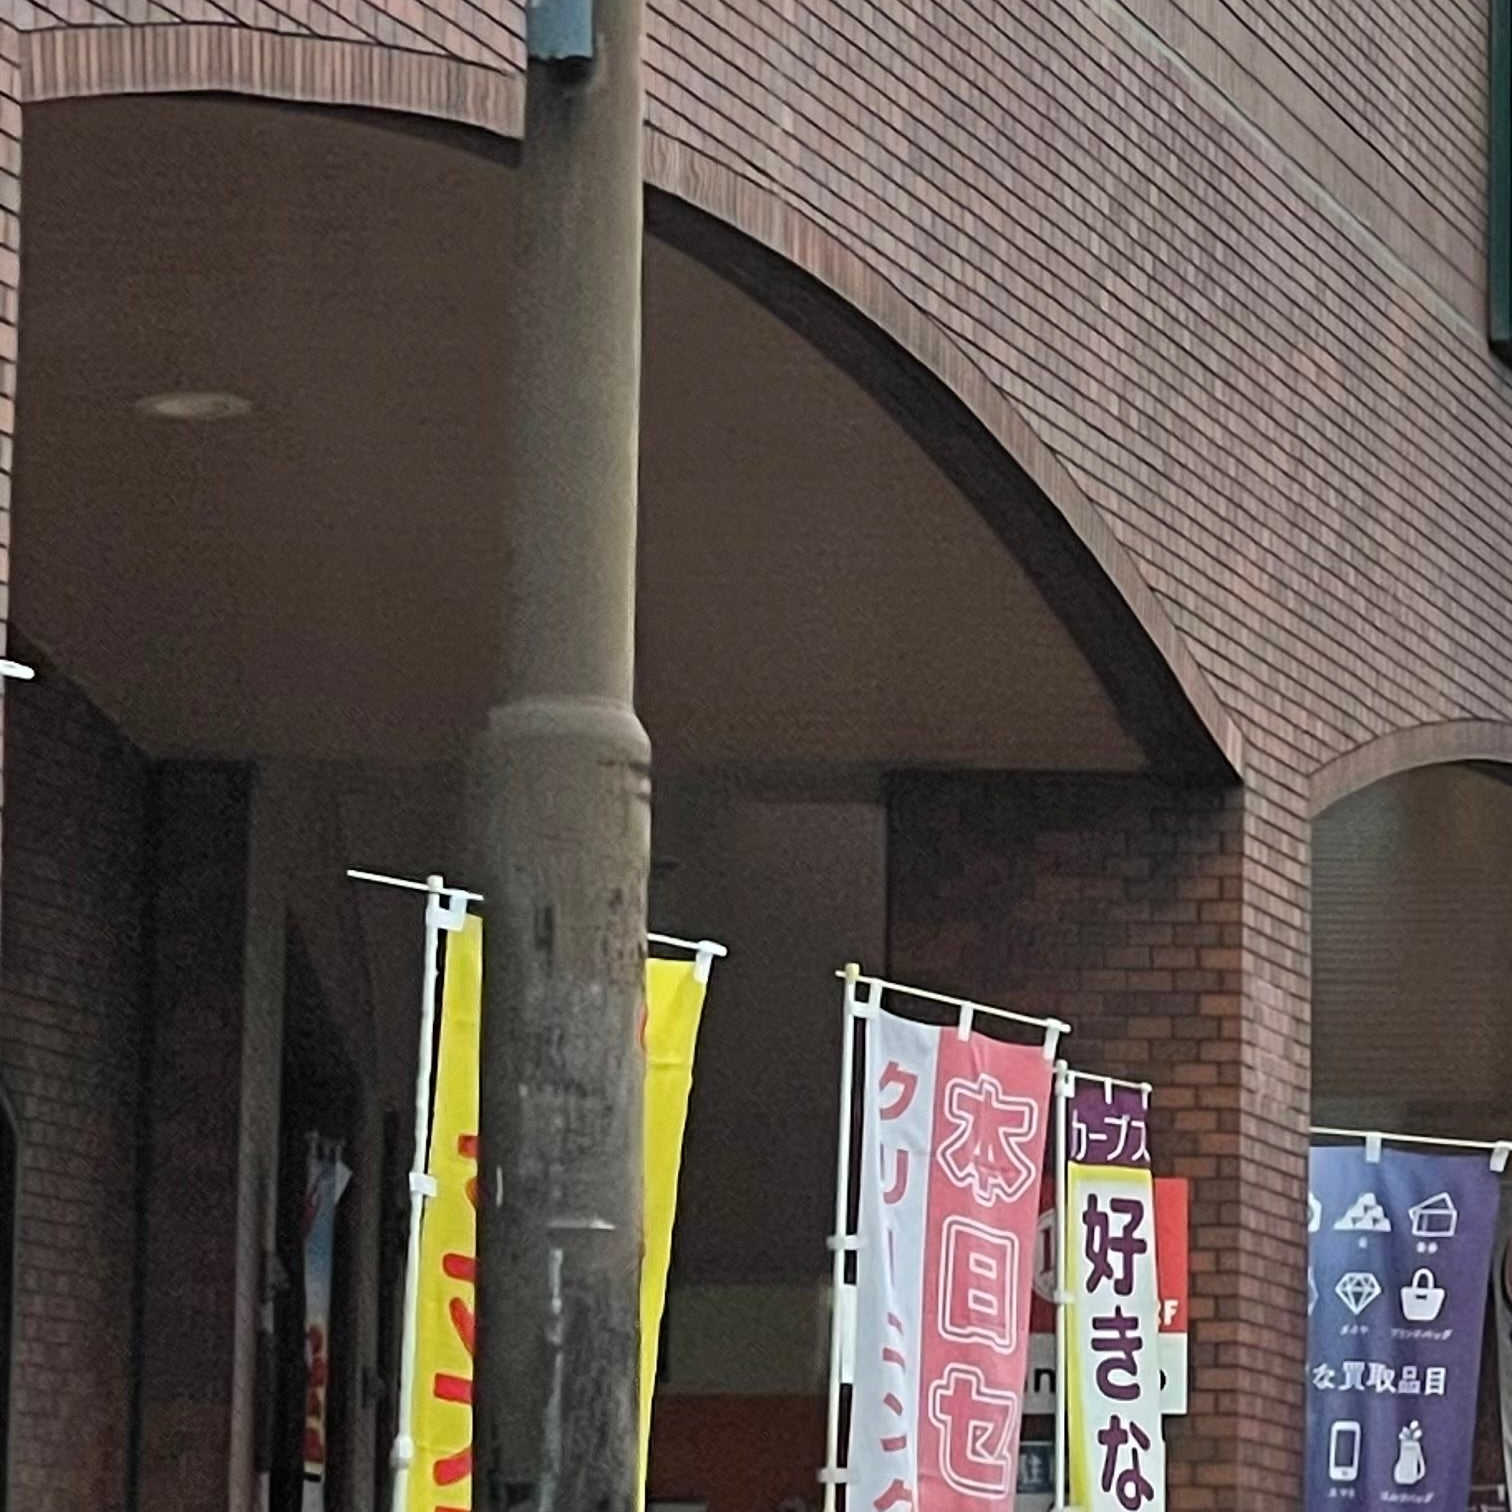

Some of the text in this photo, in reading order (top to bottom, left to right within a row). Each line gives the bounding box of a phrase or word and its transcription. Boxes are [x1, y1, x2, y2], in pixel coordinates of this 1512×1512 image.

[1071, 1109, 1151, 1162] カーブス
[1082, 1193, 1154, 1511] 好きな
[1306, 1361, 1446, 1396] な買取品目
